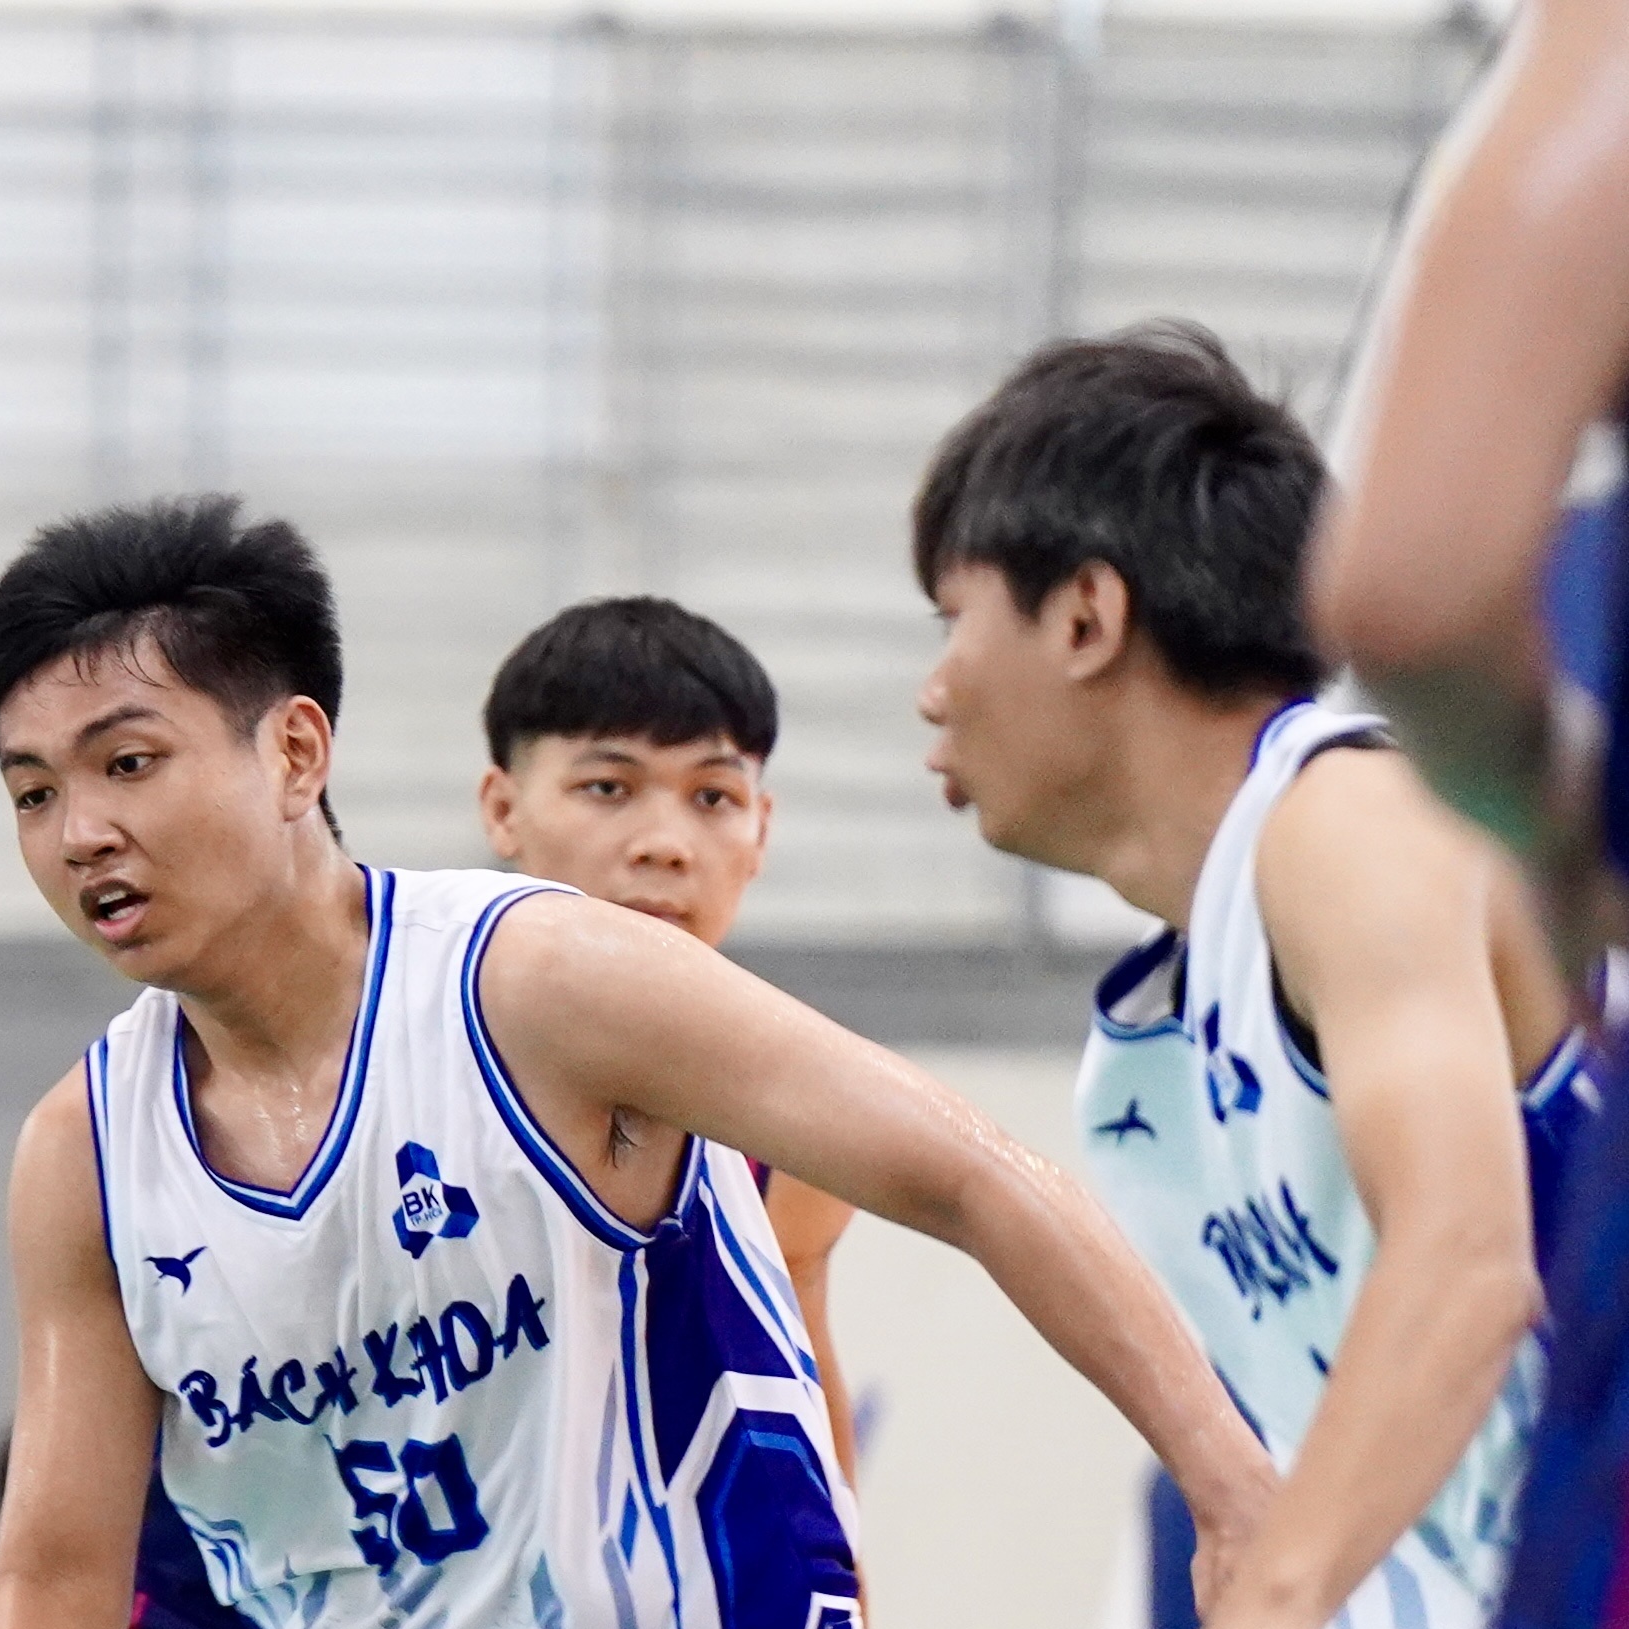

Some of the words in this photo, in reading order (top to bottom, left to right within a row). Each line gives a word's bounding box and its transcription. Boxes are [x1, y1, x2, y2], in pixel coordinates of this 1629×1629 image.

[403, 1184, 439, 1217] BK
[179, 1346, 359, 1448] BÁCH
[363, 1273, 550, 1407] KHOA
[323, 1433, 490, 1577] 50
